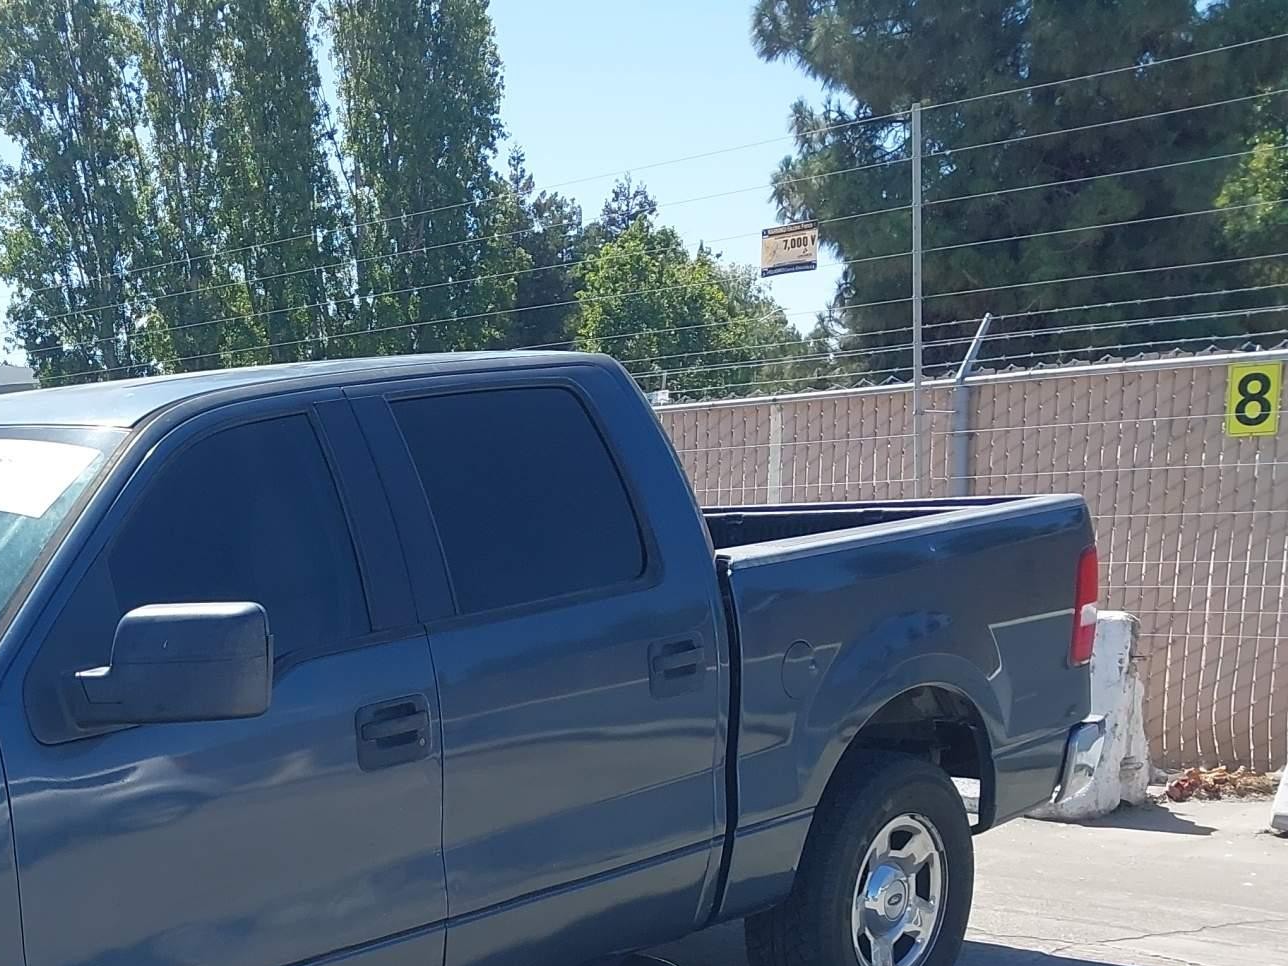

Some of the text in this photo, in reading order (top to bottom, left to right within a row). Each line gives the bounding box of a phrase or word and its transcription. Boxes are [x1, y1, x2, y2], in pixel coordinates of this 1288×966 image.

[783, 236, 808, 251] 7,000
[811, 234, 816, 246] V
[1235, 372, 1272, 426] 8
